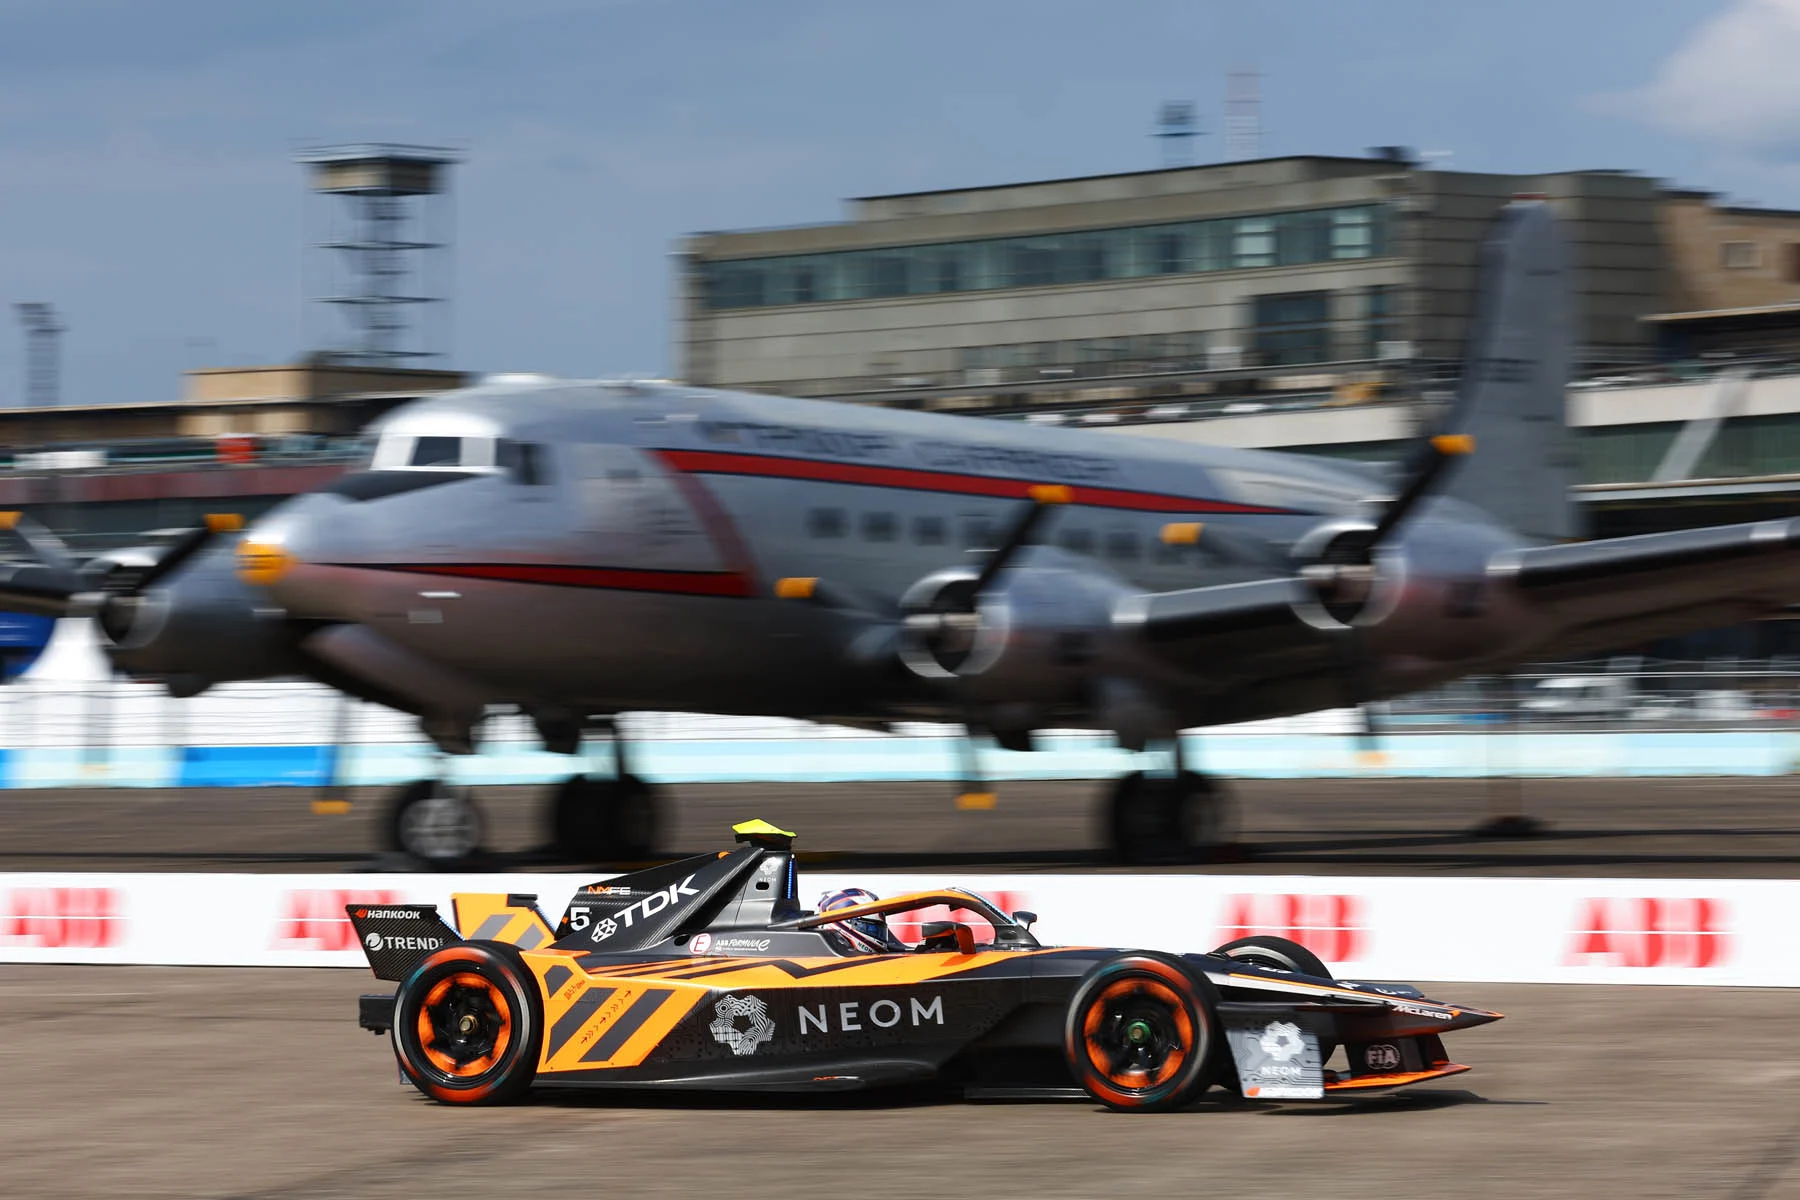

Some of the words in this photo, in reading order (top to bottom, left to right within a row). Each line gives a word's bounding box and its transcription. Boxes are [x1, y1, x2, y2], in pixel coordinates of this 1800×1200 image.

[570, 906, 591, 931] 5
[613, 873, 700, 928] TDK
[384, 936, 439, 950] TREND
[1563, 897, 1721, 967] ABB
[798, 995, 945, 1035] NEOM
